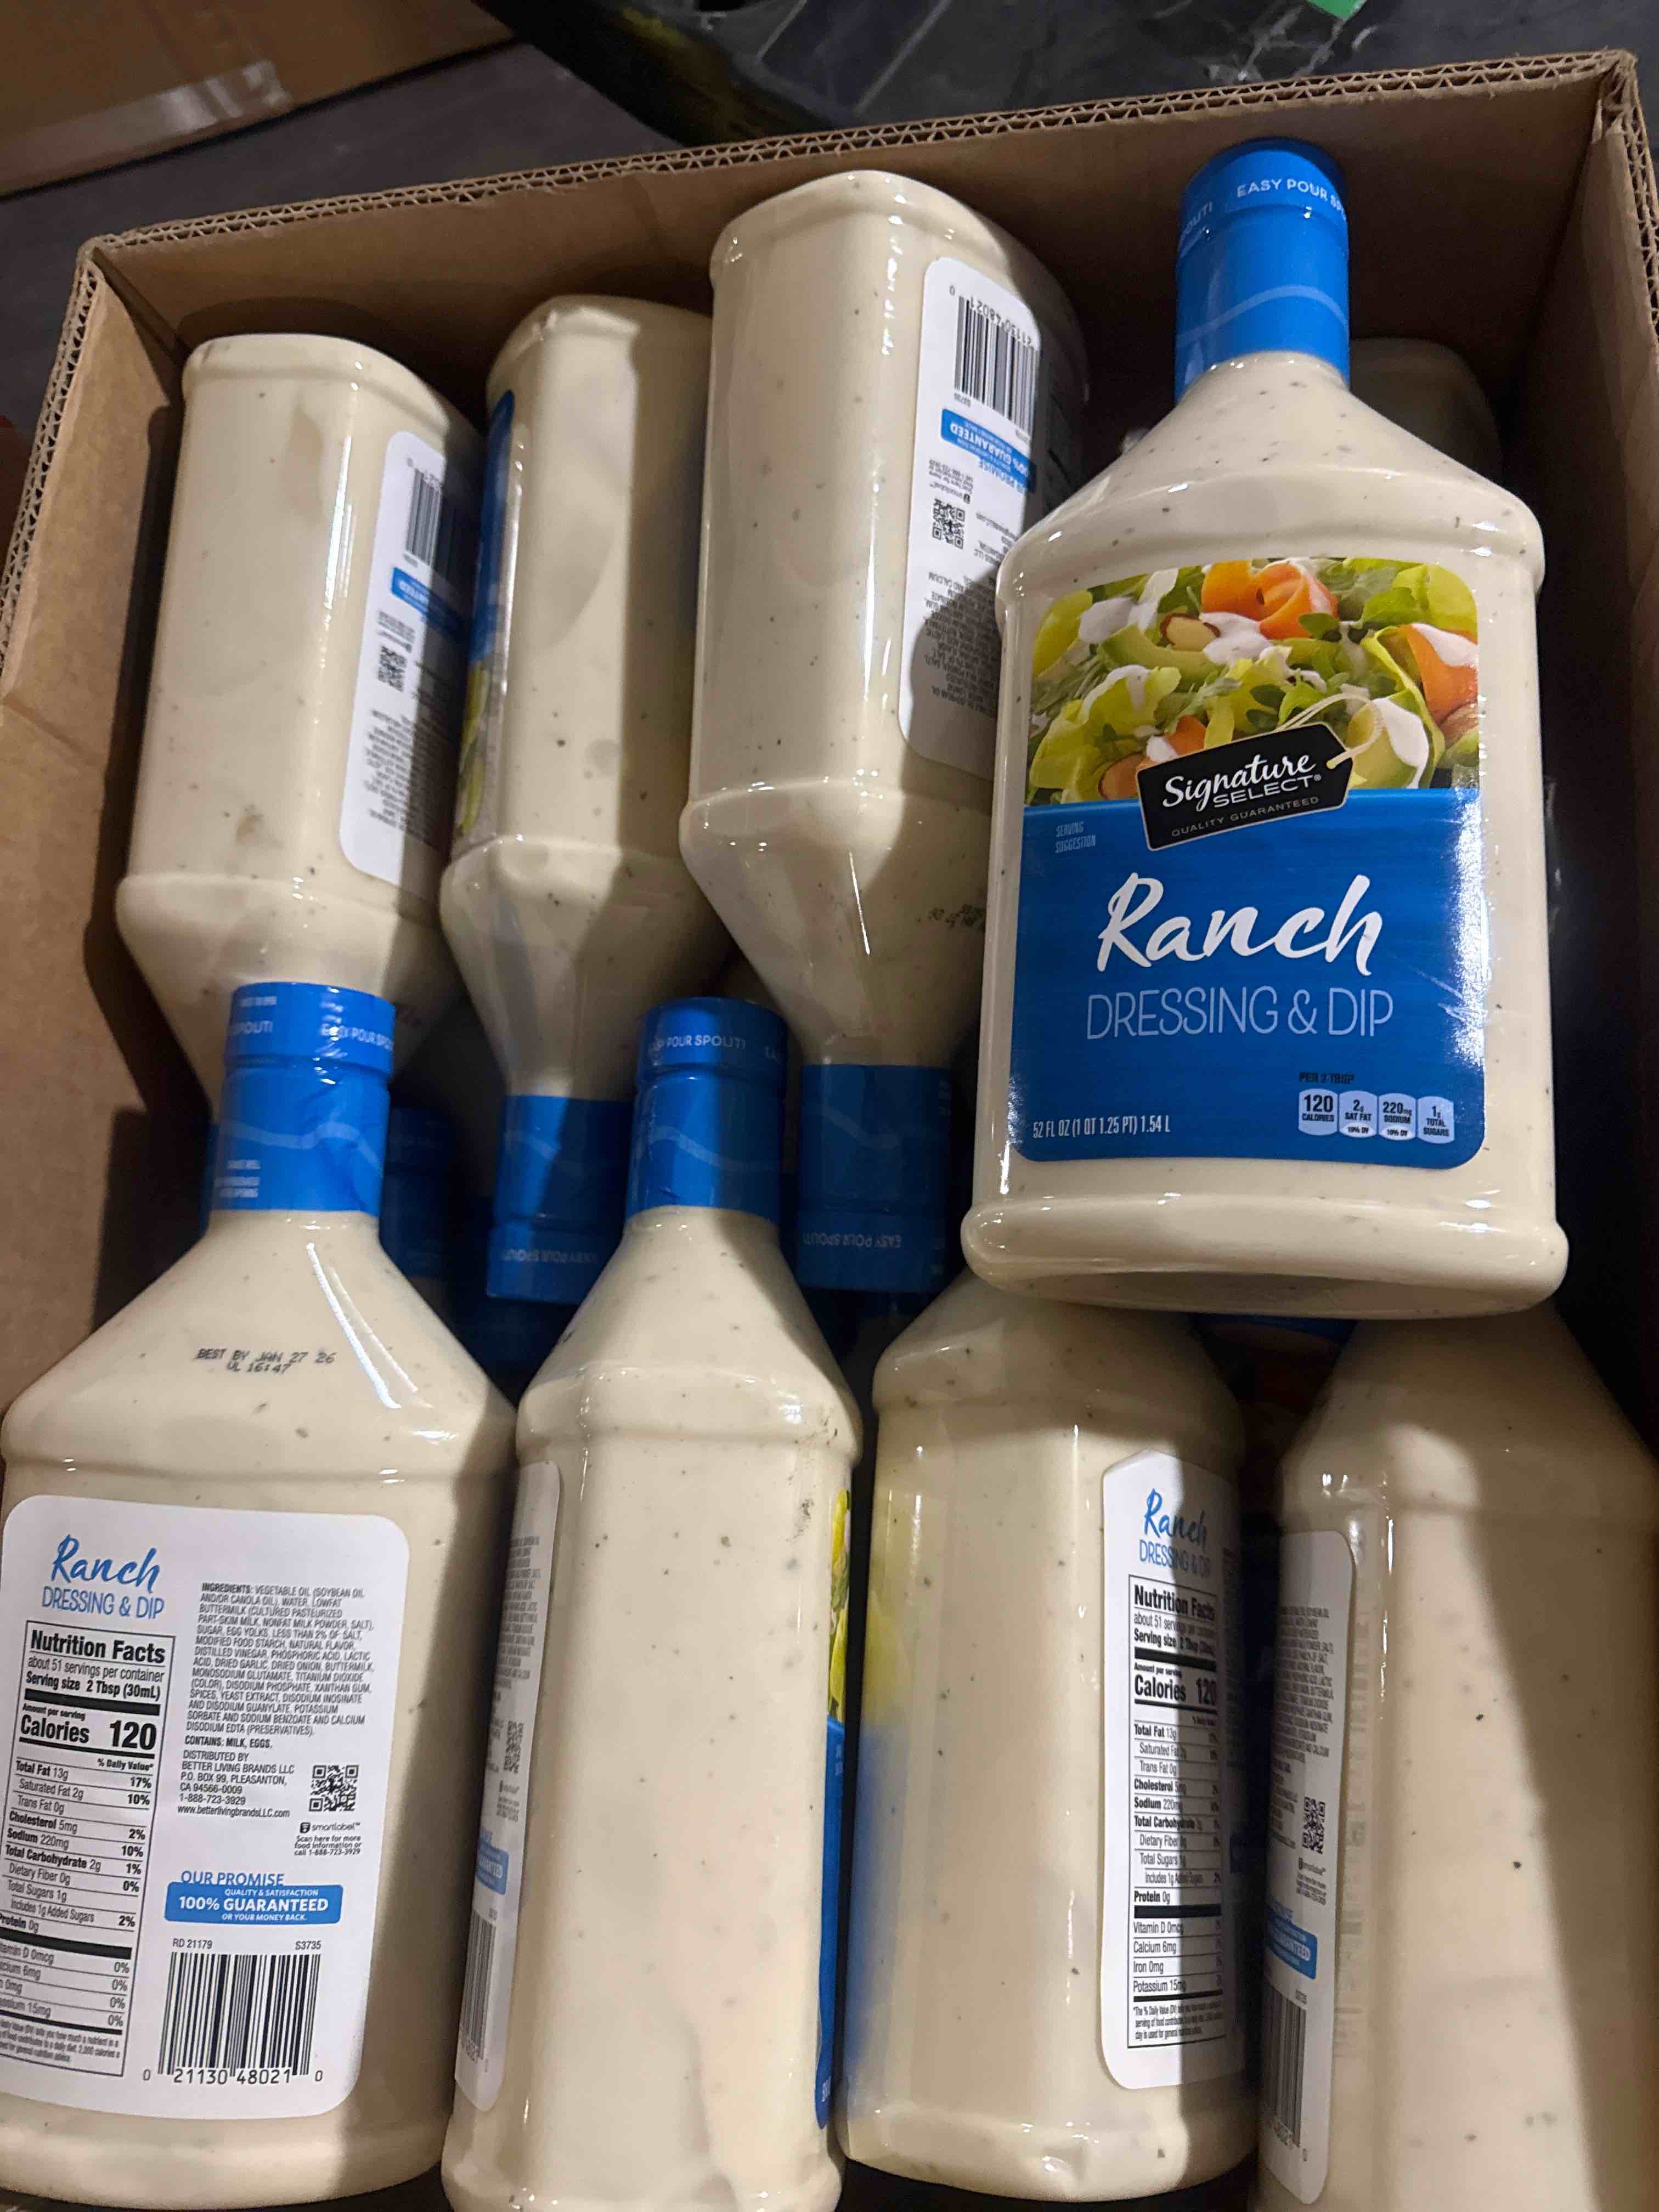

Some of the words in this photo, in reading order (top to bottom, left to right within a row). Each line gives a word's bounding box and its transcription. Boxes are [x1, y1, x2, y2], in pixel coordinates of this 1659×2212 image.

[1237, 178, 1282, 198] EASY
[1286, 178, 1328, 202] POUR
[949, 422, 1012, 467] GUARANTEED
[1163, 754, 1316, 812] Signature
[1171, 816, 1224, 837] QUALITY
[1230, 796, 1319, 822] GUARANTEED
[1054, 834, 1096, 853] SUGGESTION
[1097, 872, 1383, 976] Ranch
[1087, 986, 1278, 1039] DRESSING
[1288, 989, 1317, 1034] &
[1329, 988, 1393, 1036] DIP
[1299, 1071, 1318, 1083] PER
[1321, 1073, 1327, 1083] 2
[1304, 1094, 1333, 1113] 120
[1353, 1099, 1364, 1113] 2g
[1383, 1102, 1412, 1116] 220mg
[1345, 1113, 1357, 1121] SAT
[1384, 1115, 1410, 1124] SODIUM
[1426, 1118, 1446, 1127] TOTAL
[1033, 1121, 1043, 1138] 52
[1046, 1121, 1055, 1137] FL
[1058, 1119, 1070, 1136] OZ
[1072, 1119, 1080, 1137] (1
[1084, 1118, 1096, 1135] QT
[1099, 1116, 1119, 1134] 1.25
[1122, 1116, 1137, 1135] PT)
[1141, 1115, 1161, 1133] 1.54
[1165, 1115, 1171, 1132] L
[1423, 1127, 1449, 1137] SUGARS
[195, 1348, 228, 1360] BEST
[232, 1350, 250, 1362] BY
[255, 1351, 284, 1363] JAN
[289, 1352, 308, 1364] 27
[227, 1361, 240, 1372] UL
[1144, 1488, 1206, 1552] Ranch
[1139, 1539, 1189, 1573] DRESSING
[50, 1534, 160, 1593] Ranch
[256, 1585, 296, 1596] VEGETABLE
[42, 1586, 114, 1616] DRESSING
[119, 1600, 131, 1616] &
[136, 1597, 165, 1620] DIP
[1134, 1584, 1188, 1616] Nutrition
[1134, 1629, 1161, 1648] Serving
[1163, 1634, 1176, 1647] size
[30, 1629, 106, 1658] Nutrition
[112, 1640, 166, 1664] Facts
[28, 1656, 50, 1669] about
[52, 1661, 62, 1672] 51
[65, 1662, 100, 1678] servings
[103, 1668, 118, 1679] per
[120, 1671, 165, 1683] container
[26, 1672, 59, 1689] Serving
[61, 1678, 80, 1691] size
[86, 1680, 93, 1692] 2
[97, 1682, 120, 1698] Tbsp
[123, 1684, 161, 1701] (30mL)
[1134, 1674, 1186, 1701] Calories
[21, 1714, 89, 1743] Calories
[110, 1720, 156, 1750] 120
[1134, 1724, 1152, 1736] Total
[1154, 1726, 1165, 1737] Fat
[185, 1735, 224, 1747] CONTAINS:
[225, 1737, 247, 1748] MILK,
[250, 1739, 273, 1748] EGGS.
[183, 1750, 235, 1762] DISTRIBUTED
[238, 1753, 249, 1762] BY
[16, 1760, 35, 1774] Total
[37, 1765, 50, 1776] Fat
[53, 1768, 69, 1781] 13g
[106, 1759, 126, 1770] Daily
[182, 1761, 213, 1772] BETTER
[215, 1763, 240, 1773] LIVING
[242, 1764, 277, 1773] BRANDS
[279, 1764, 295, 1774] LLC
[131, 1776, 151, 1789] 17%
[196, 1773, 213, 1782] BOX
[230, 1775, 287, 1787] PLEASANTON,
[1134, 1780, 1173, 1792] Cholesterol
[180, 1782, 191, 1792] CA
[193, 1784, 242, 1794] 94566-0009
[128, 1793, 150, 1805] 10%
[179, 1793, 246, 1805] 1-888-723-3929
[1134, 1797, 1161, 1810] Sodium
[9, 1811, 56, 1829] Cholesterol
[59, 1819, 78, 1833] 5mg
[7, 1828, 38, 1843] Sodium
[40, 1834, 69, 1850] 220mg
[129, 1829, 145, 1840] 2%
[5, 1844, 25, 1858] Total
[27, 1848, 87, 1869] Carbohydrate
[89, 1859, 101, 1871] 2g
[121, 1846, 143, 1858] 10%
[126, 1863, 142, 1875] 1%
[180, 1870, 213, 1884] OUR
[218, 1872, 285, 1886] PROMISE
[123, 1881, 139, 1893] 0%
[224, 1888, 257, 1897] QUALITY
[179, 1896, 220, 1910] 100%
[223, 1898, 328, 1911] GUARANTEED
[1134, 1891, 1160, 1903] Protein
[172, 1938, 185, 1948] RD
[187, 1939, 212, 1949] 21179
[295, 1940, 321, 1950] S3735
[1133, 1941, 1161, 1954] Calcium
[1163, 1941, 1177, 1955] 6mg
[143, 2069, 151, 2081] 0
[173, 2068, 228, 2084] 21130
[236, 2068, 290, 2084] 48021
[315, 2070, 323, 2081] 0
